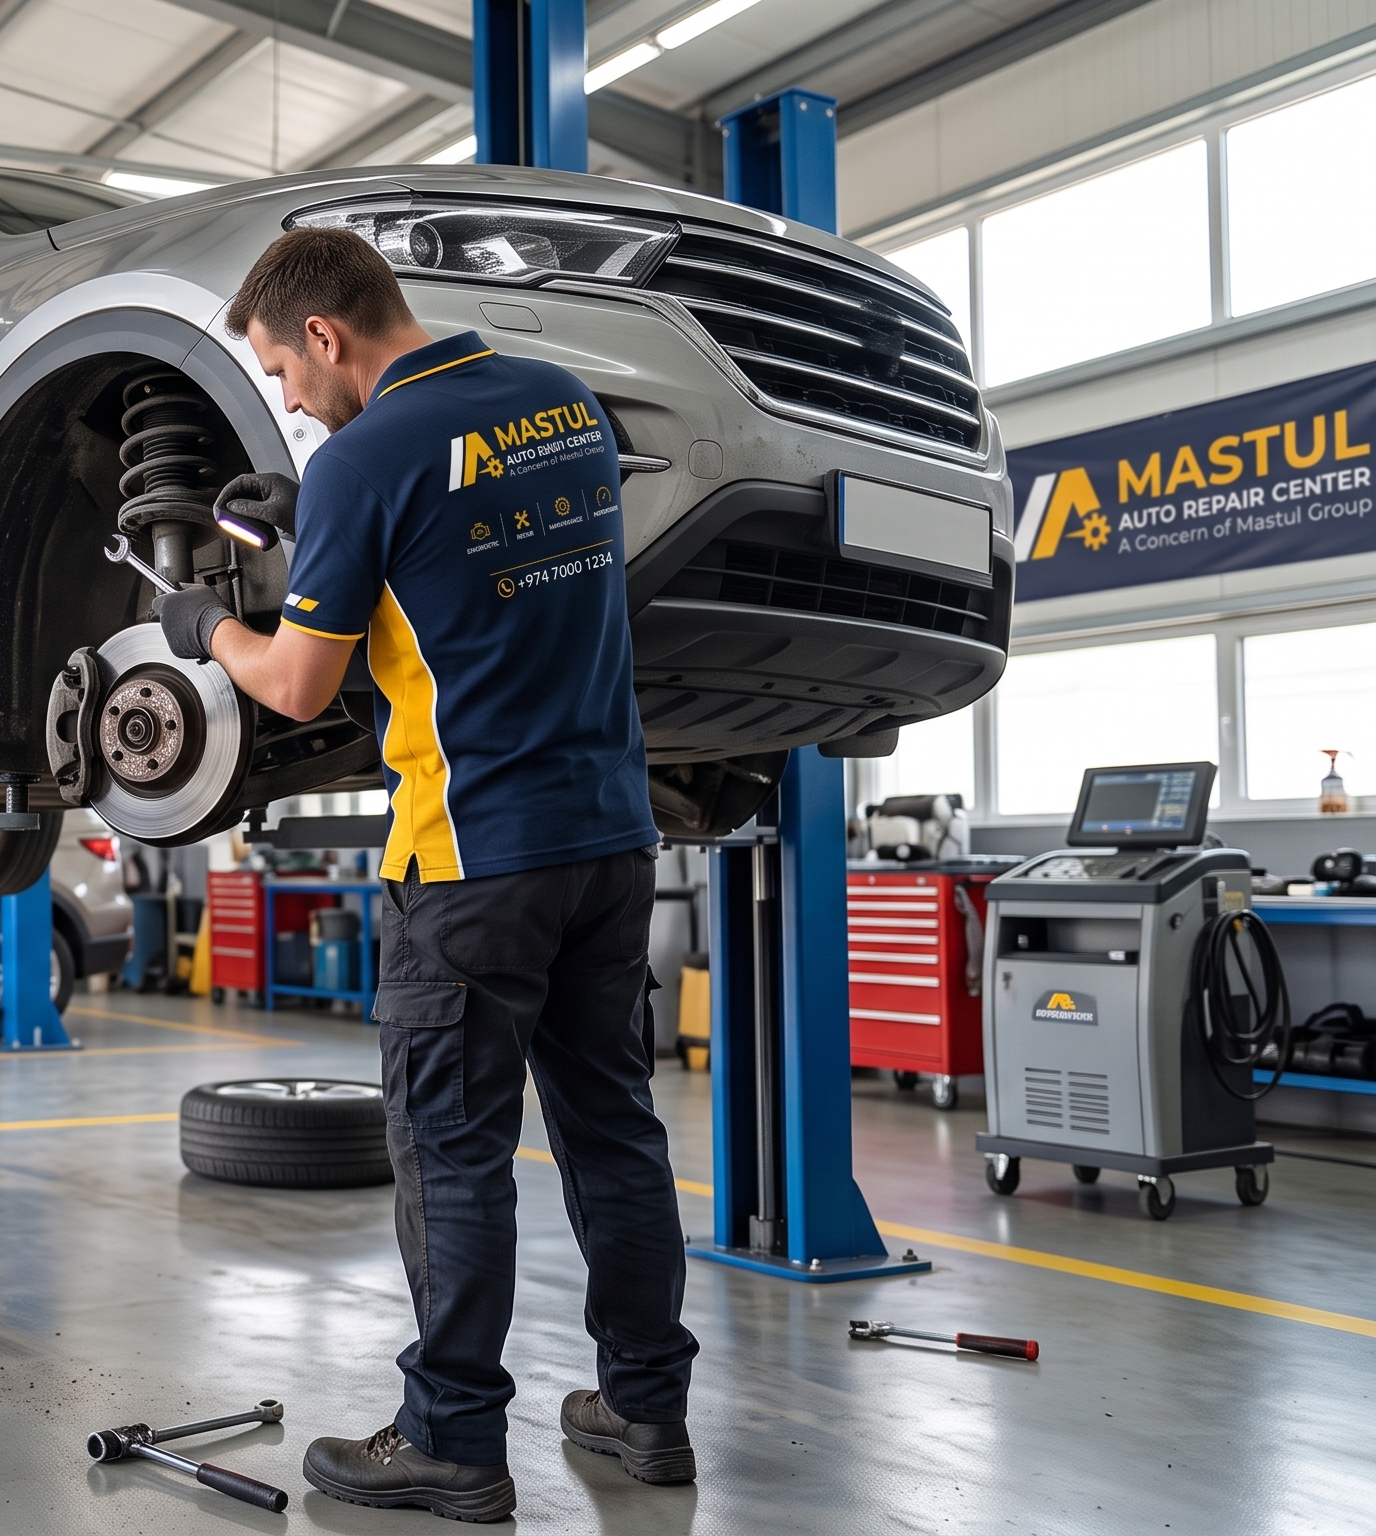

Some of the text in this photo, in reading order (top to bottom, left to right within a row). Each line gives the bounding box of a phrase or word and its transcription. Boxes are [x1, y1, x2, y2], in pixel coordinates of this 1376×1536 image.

[493, 402, 598, 451] MASTUL
[507, 449, 536, 466] AUTO
[567, 431, 603, 448] CENTER
[1118, 409, 1371, 503] MASTUL
[1118, 467, 1371, 532] AUTO REPAIR CENTER
[1118, 497, 1373, 554] A Concern of Mastul Group
[517, 551, 613, 588] +974 7000 1234
